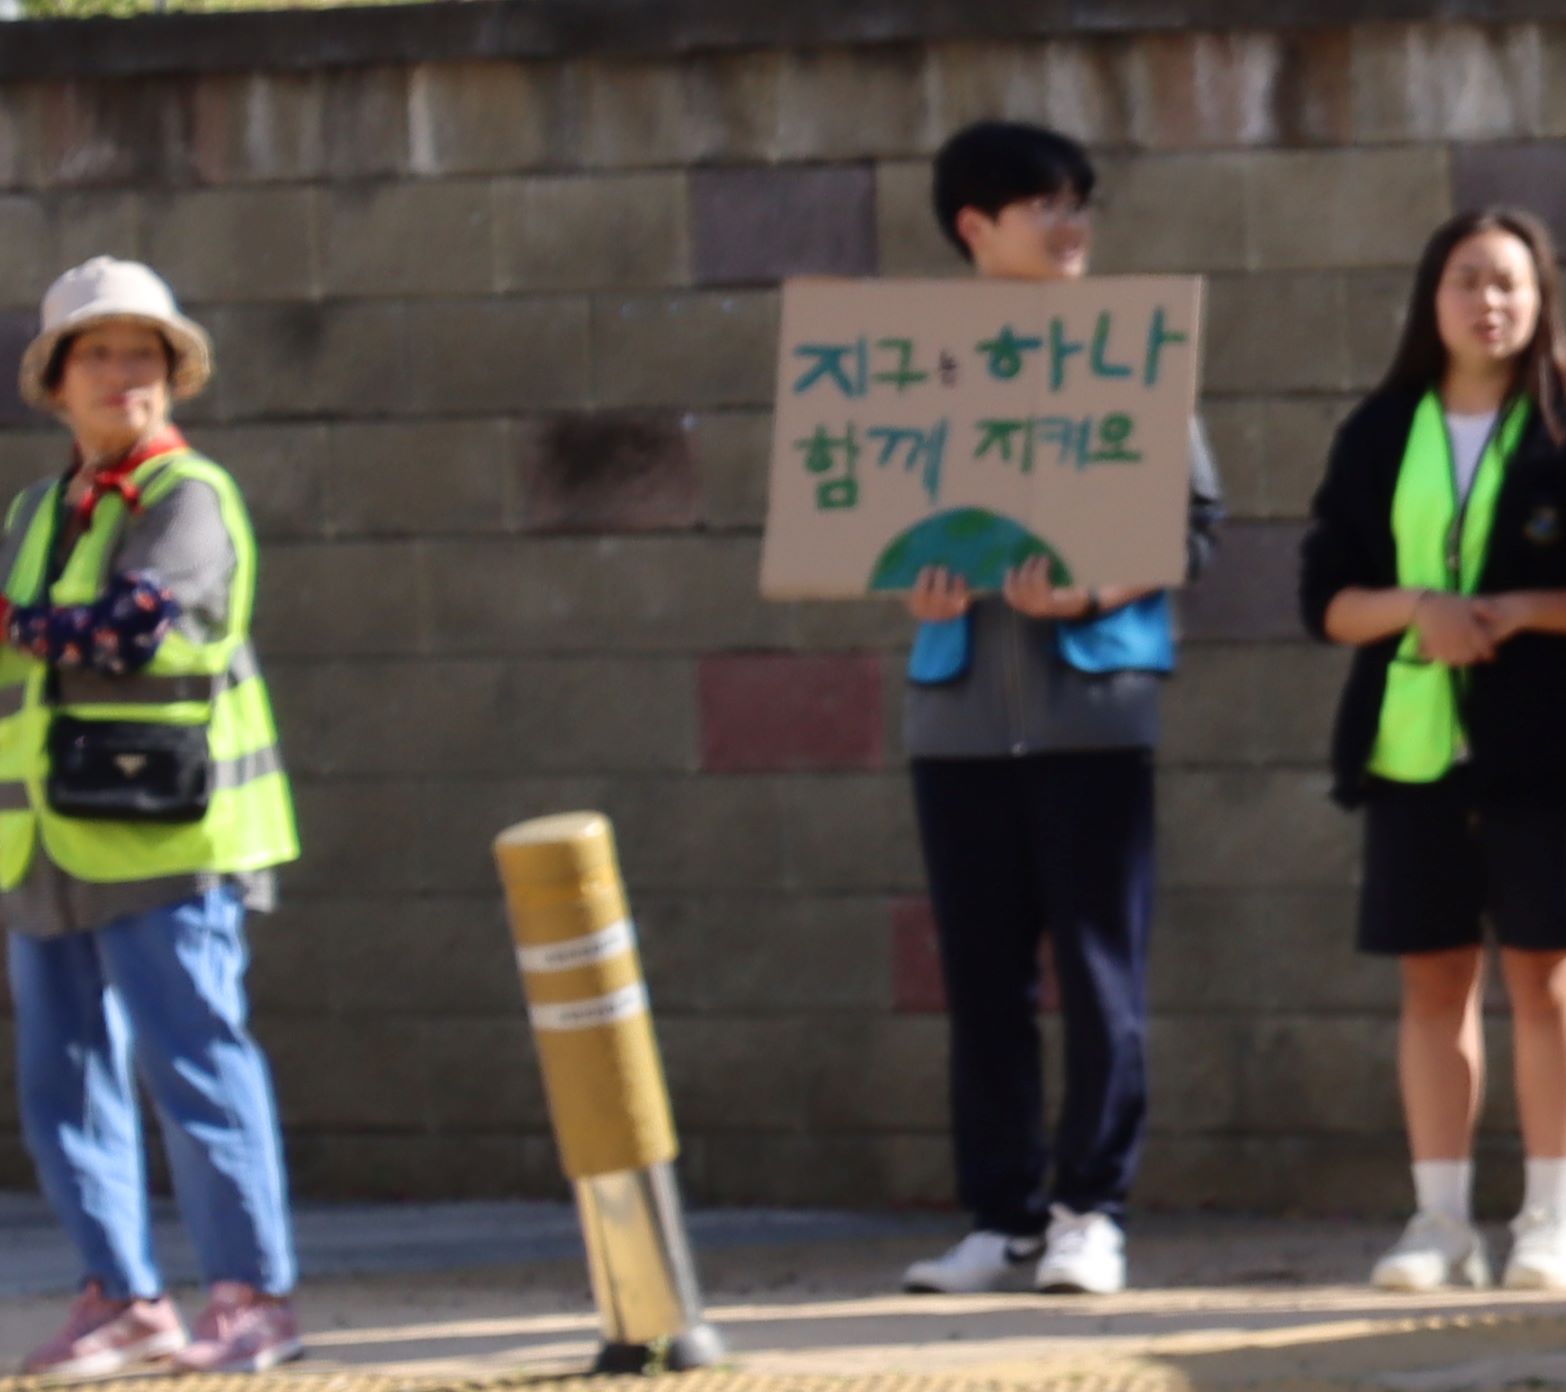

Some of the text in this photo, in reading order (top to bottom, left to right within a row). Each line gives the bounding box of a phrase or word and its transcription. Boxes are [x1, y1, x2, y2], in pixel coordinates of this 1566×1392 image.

[977, 307, 1187, 393] 하나
[794, 413, 1143, 510] 함께 지켜요
